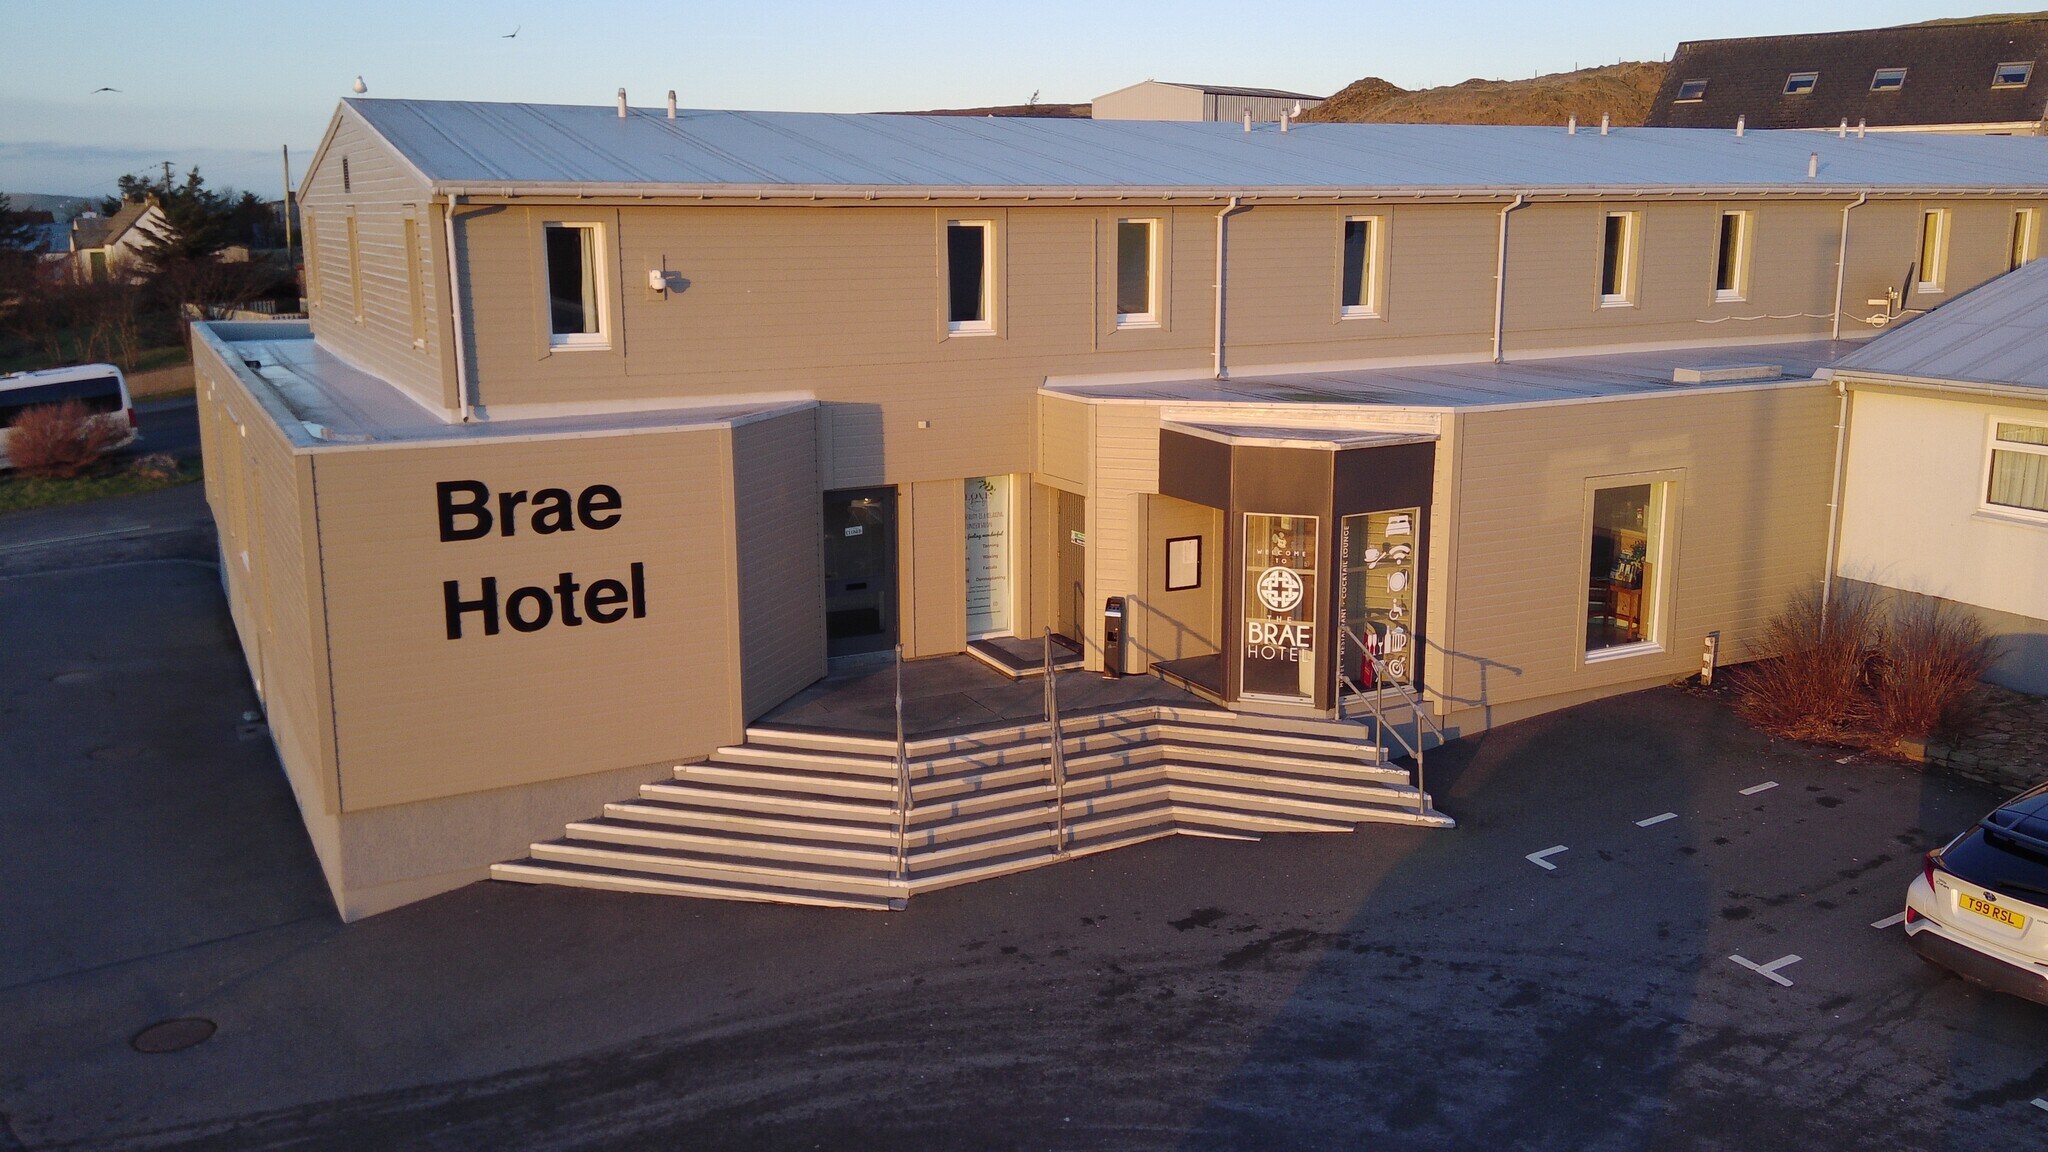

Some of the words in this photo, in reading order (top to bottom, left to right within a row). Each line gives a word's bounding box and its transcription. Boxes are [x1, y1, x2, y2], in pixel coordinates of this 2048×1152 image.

[436, 480, 622, 542] Brae
[1256, 549, 1306, 558] WELCOME
[1342, 525, 1350, 558] LOUNGE
[1341, 560, 1349, 599] COCKTAIL
[443, 562, 646, 640] Hotel
[1266, 615, 1293, 624] THE
[1248, 622, 1311, 647] BRAE
[1247, 645, 1312, 663] HOTEL
[1968, 897, 1991, 915] T99
[1992, 908, 2015, 925] RSL
